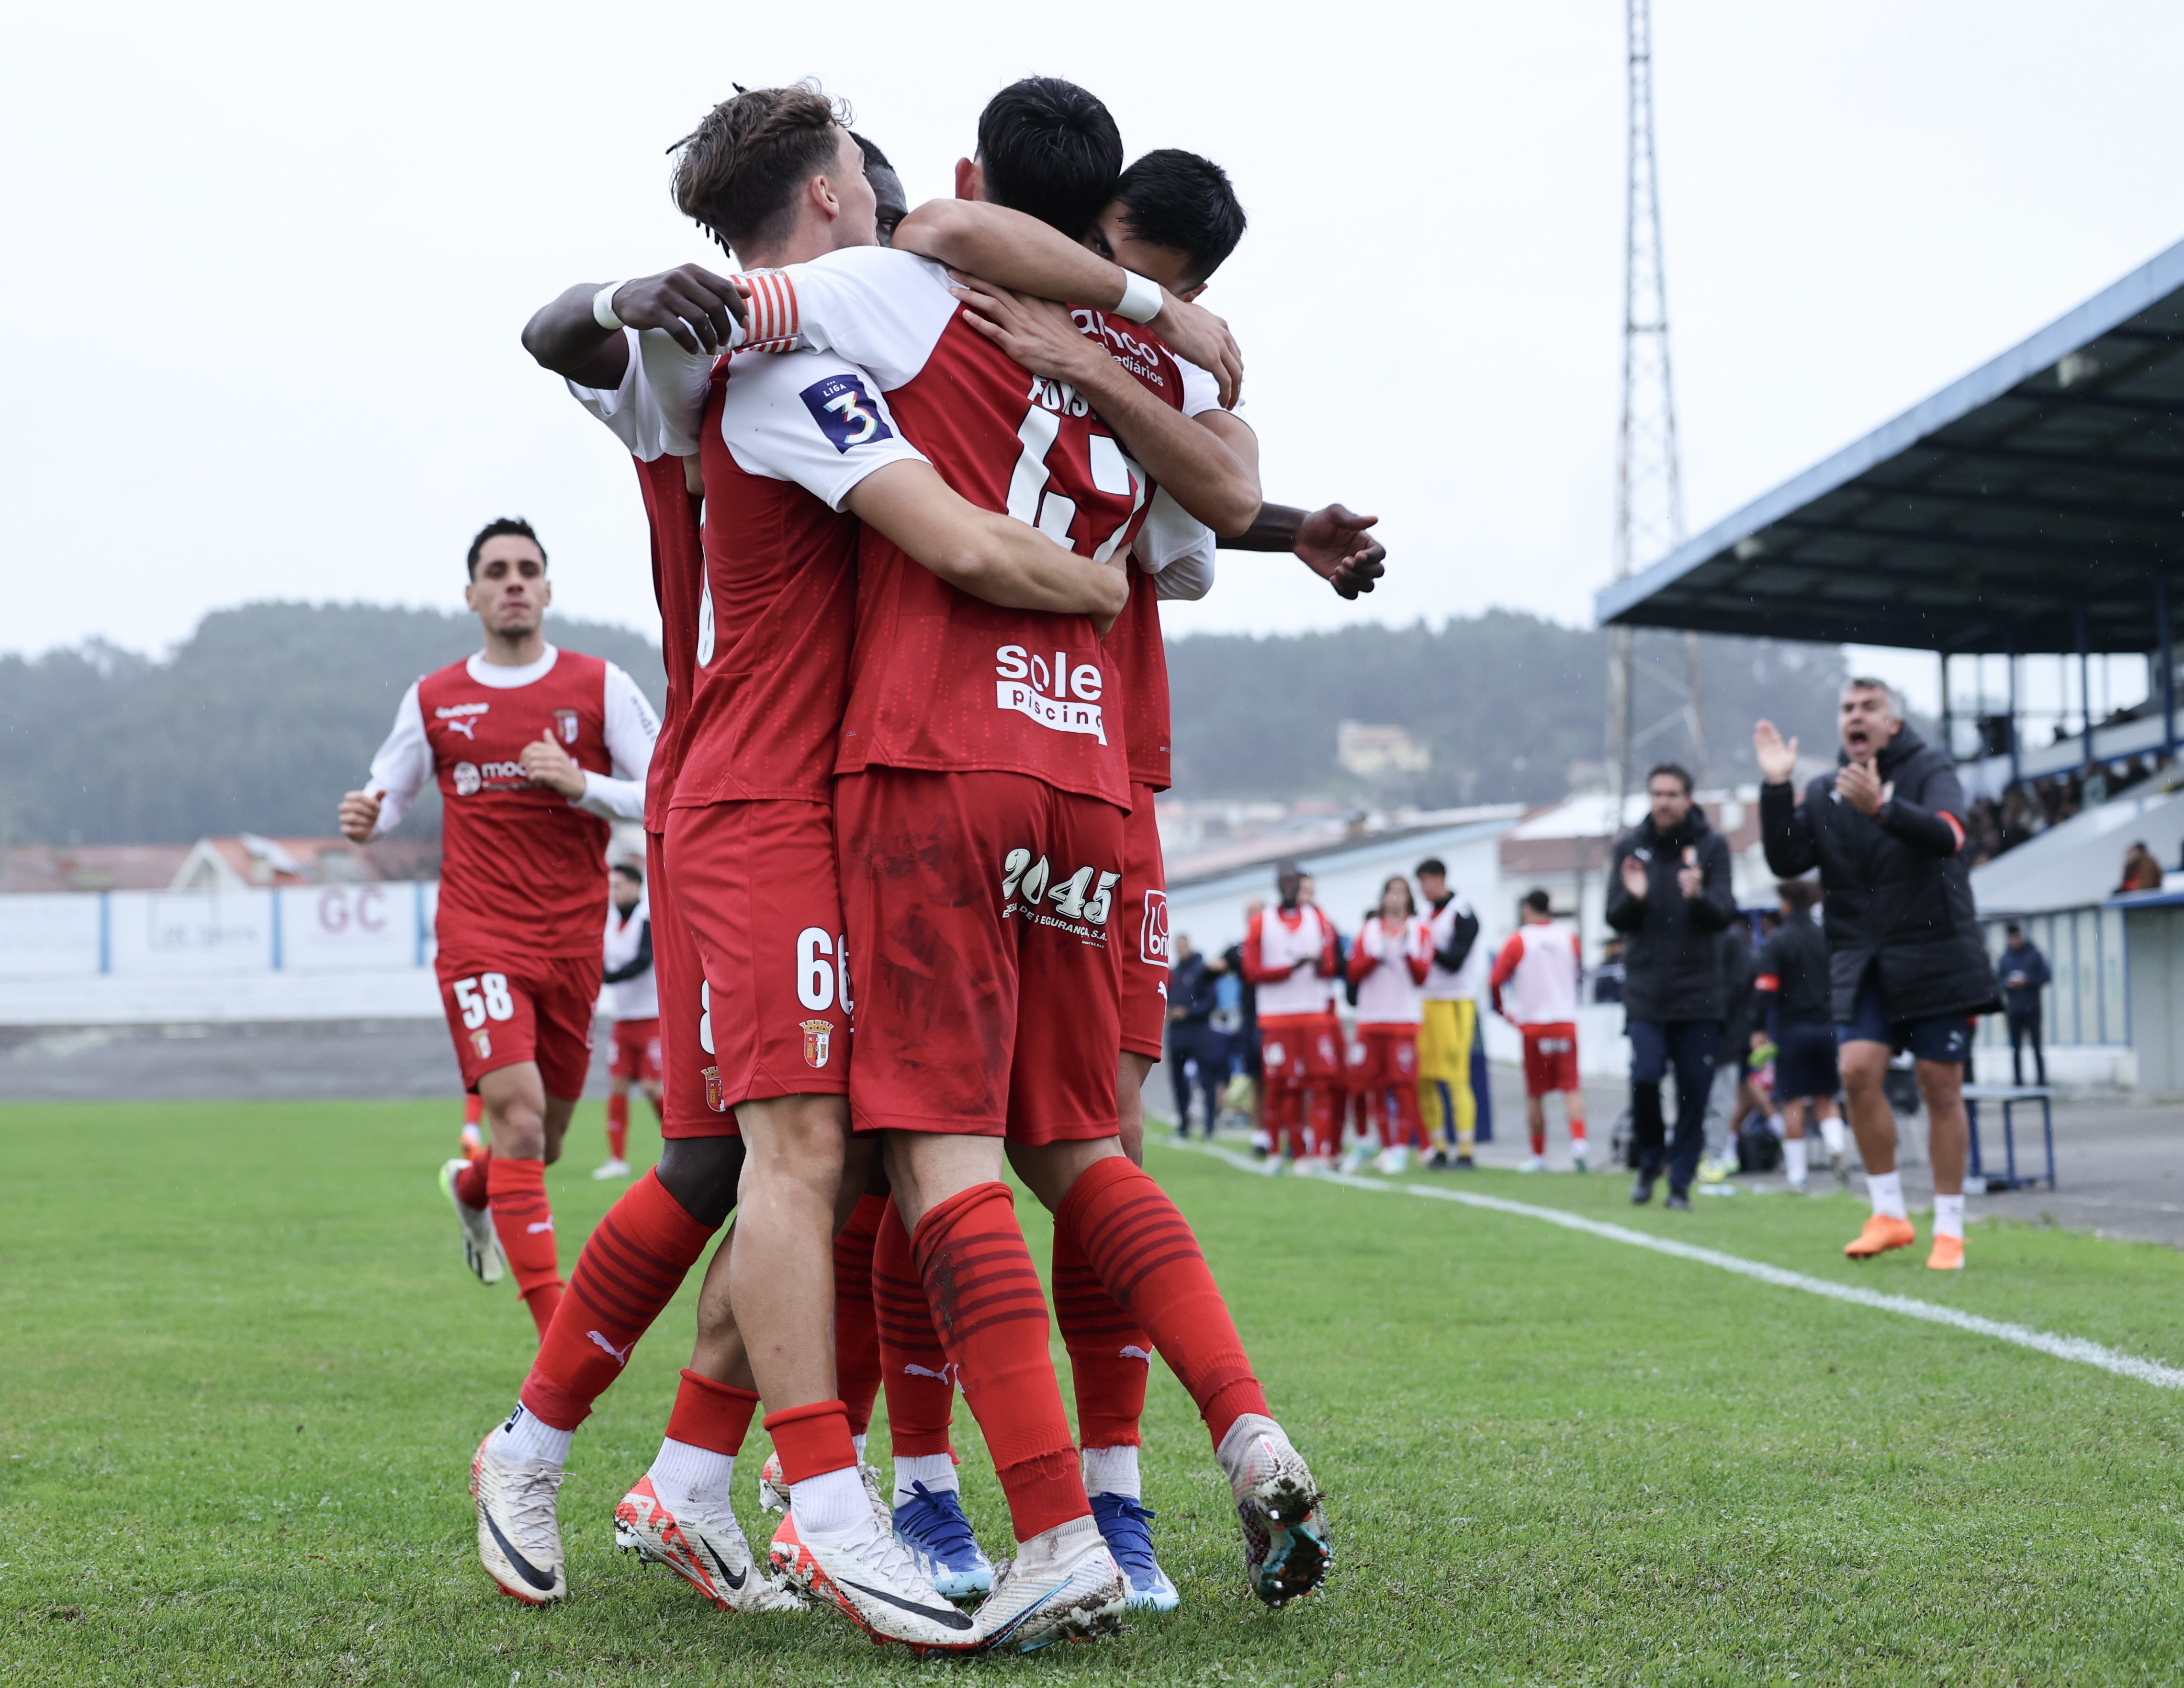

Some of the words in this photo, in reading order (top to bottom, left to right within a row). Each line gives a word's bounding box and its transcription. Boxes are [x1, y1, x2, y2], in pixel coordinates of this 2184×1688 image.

[1070, 309, 1159, 366] anco
[822, 384, 847, 397] LIGA
[822, 391, 878, 444] 3
[1002, 848, 1121, 925] 2045
[1019, 905, 1035, 920] DE
[1091, 930, 1108, 941] S.A.
[453, 972, 515, 1030] 58
